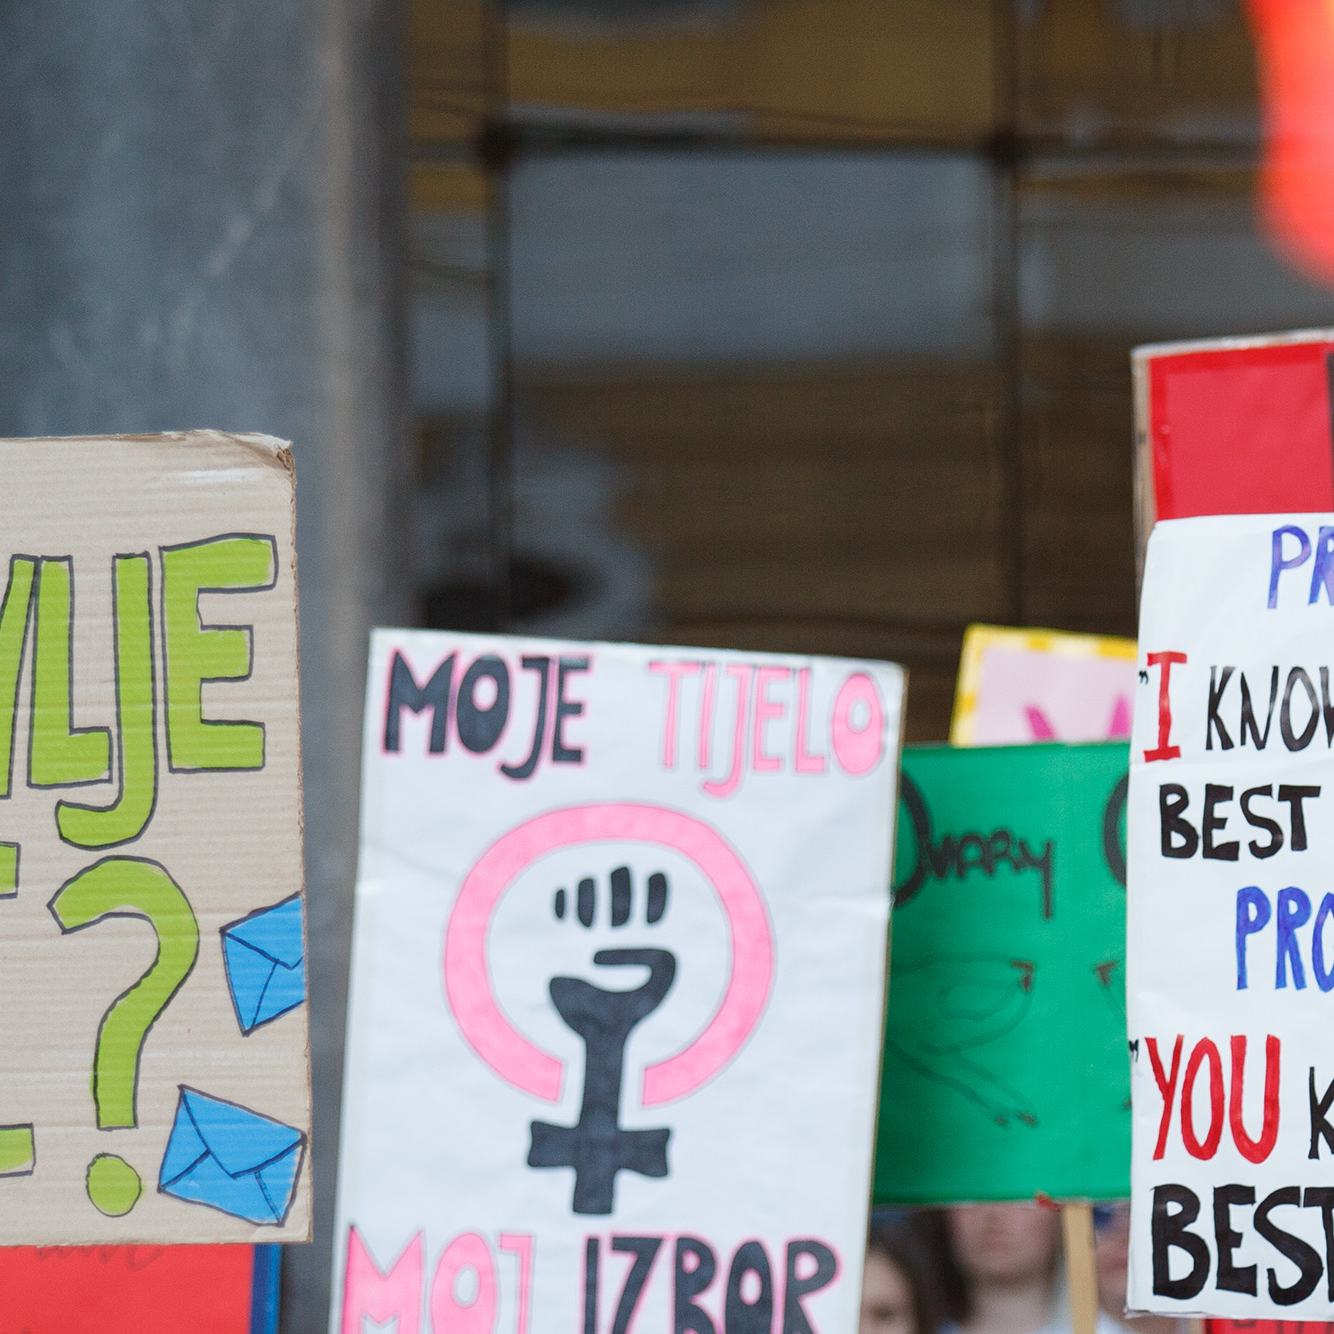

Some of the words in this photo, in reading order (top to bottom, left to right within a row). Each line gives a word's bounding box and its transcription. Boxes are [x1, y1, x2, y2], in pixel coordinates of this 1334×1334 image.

[382, 649, 594, 782] MOJE
[648, 658, 888, 799] TIJELO
[1159, 784, 1322, 861] BEST
